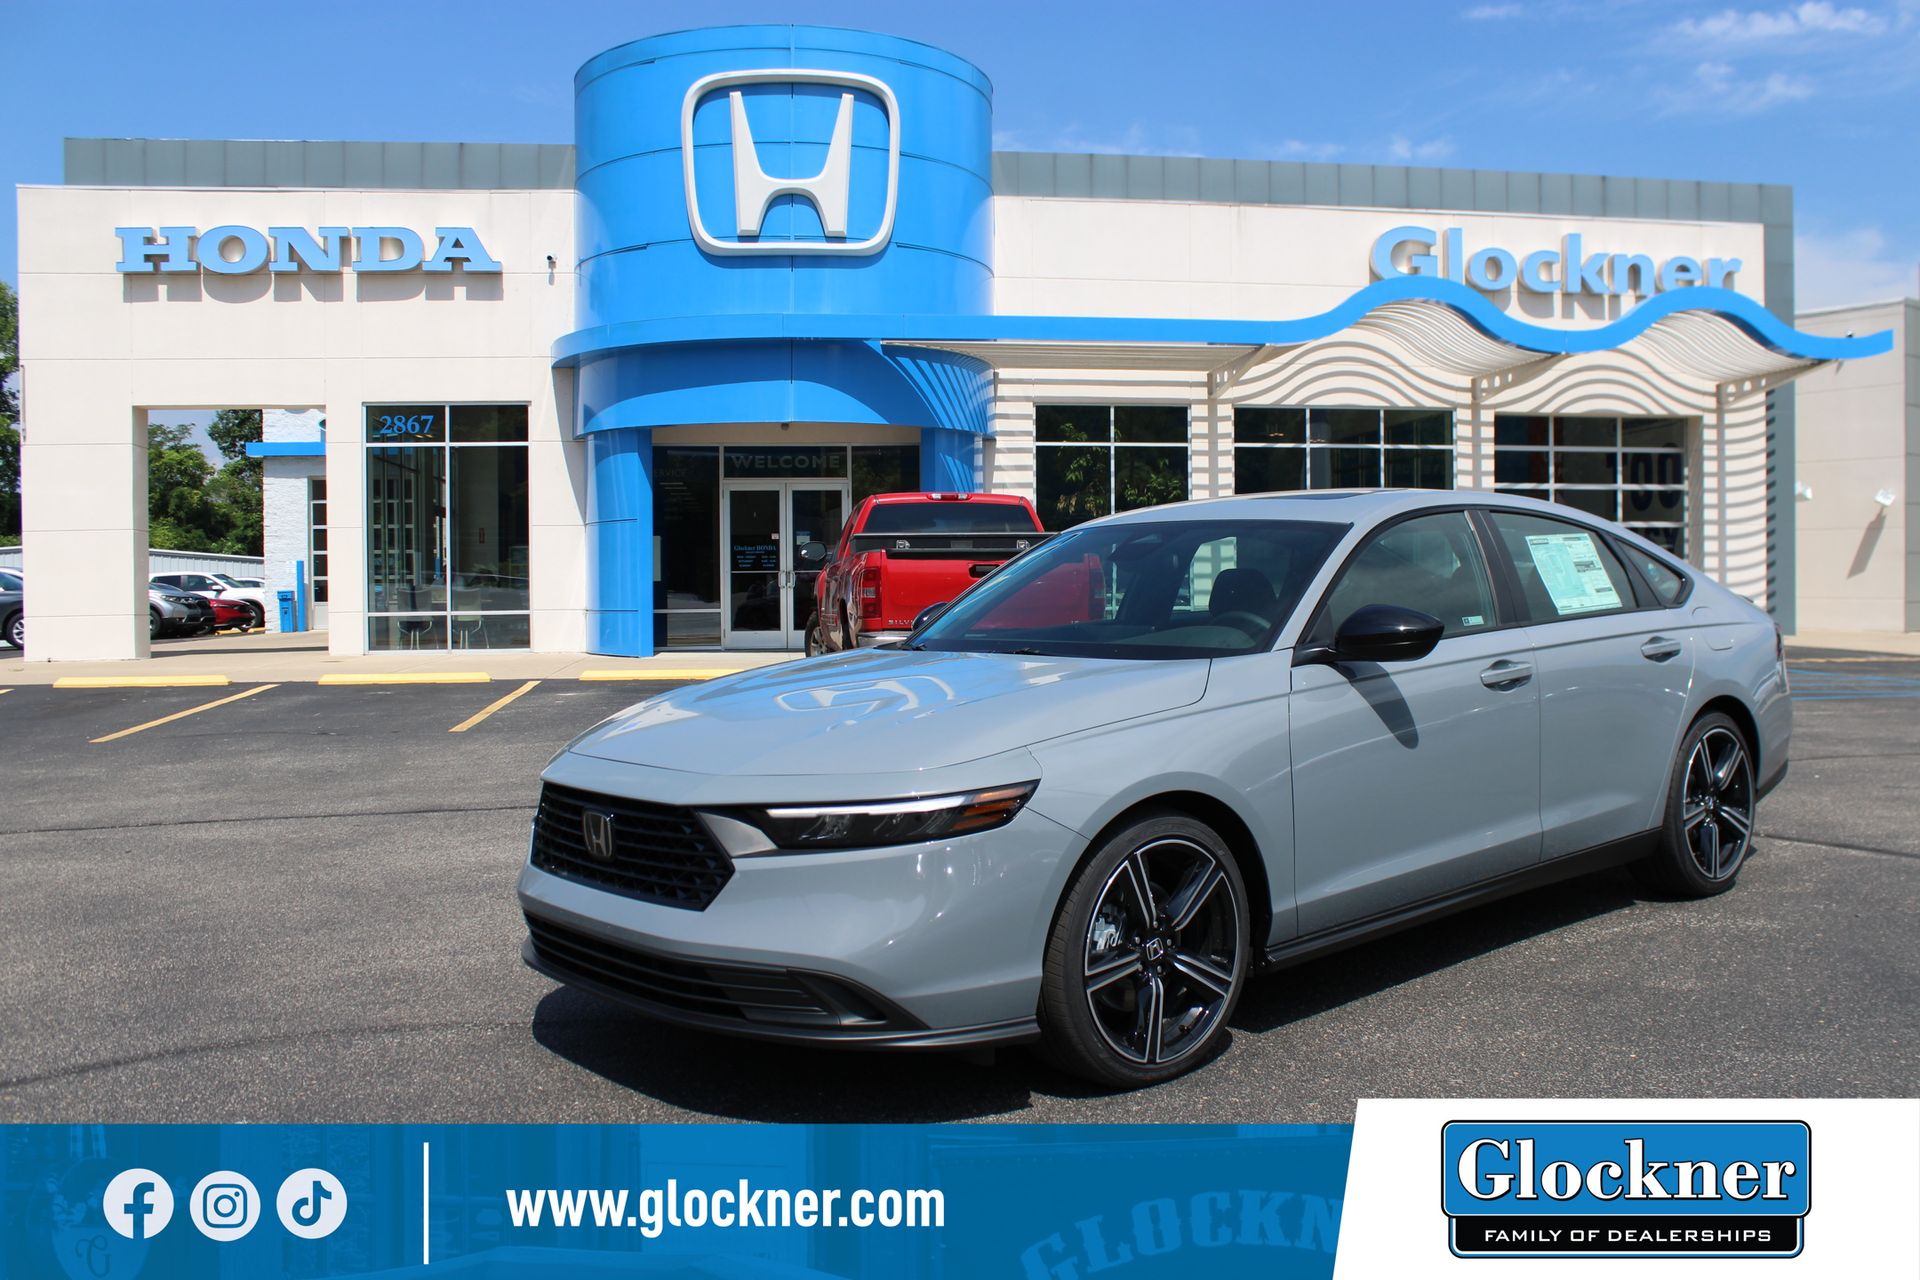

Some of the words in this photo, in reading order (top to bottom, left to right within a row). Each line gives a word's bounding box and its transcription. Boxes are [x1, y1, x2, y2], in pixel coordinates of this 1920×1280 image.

[114, 224, 502, 273] HONDA
[1370, 225, 1744, 295] Glockner
[380, 415, 434, 434] 2867
[731, 455, 841, 469] WELCOME
